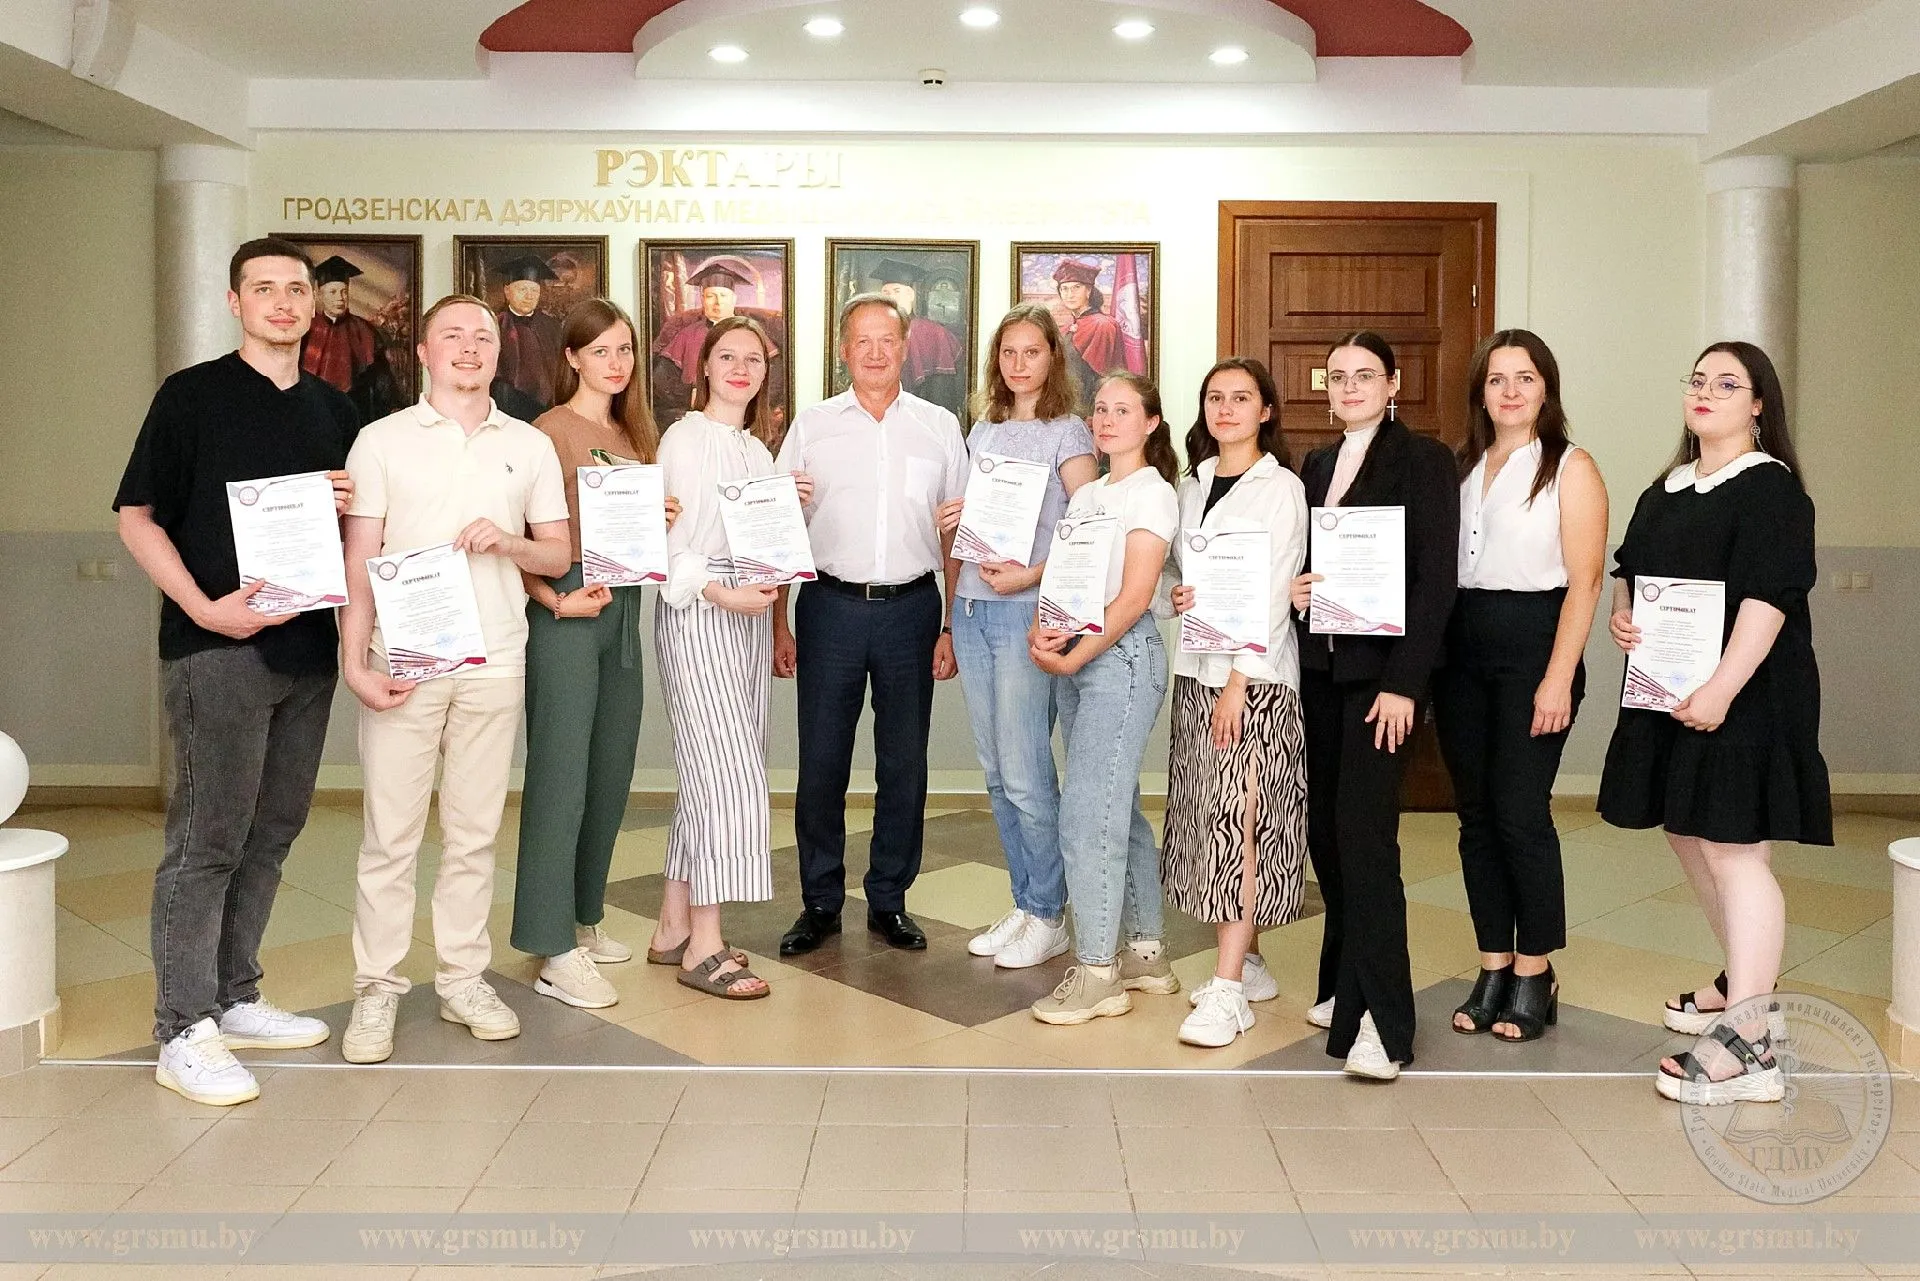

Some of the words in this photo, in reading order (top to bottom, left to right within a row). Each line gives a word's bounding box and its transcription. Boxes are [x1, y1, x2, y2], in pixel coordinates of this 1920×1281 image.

[593, 148, 844, 189] РЭКТАРЫ
[282, 196, 493, 225] ГРОДЗЕНСКАГА
[499, 193, 704, 226] ДЗЯРЖАЎНАГА
